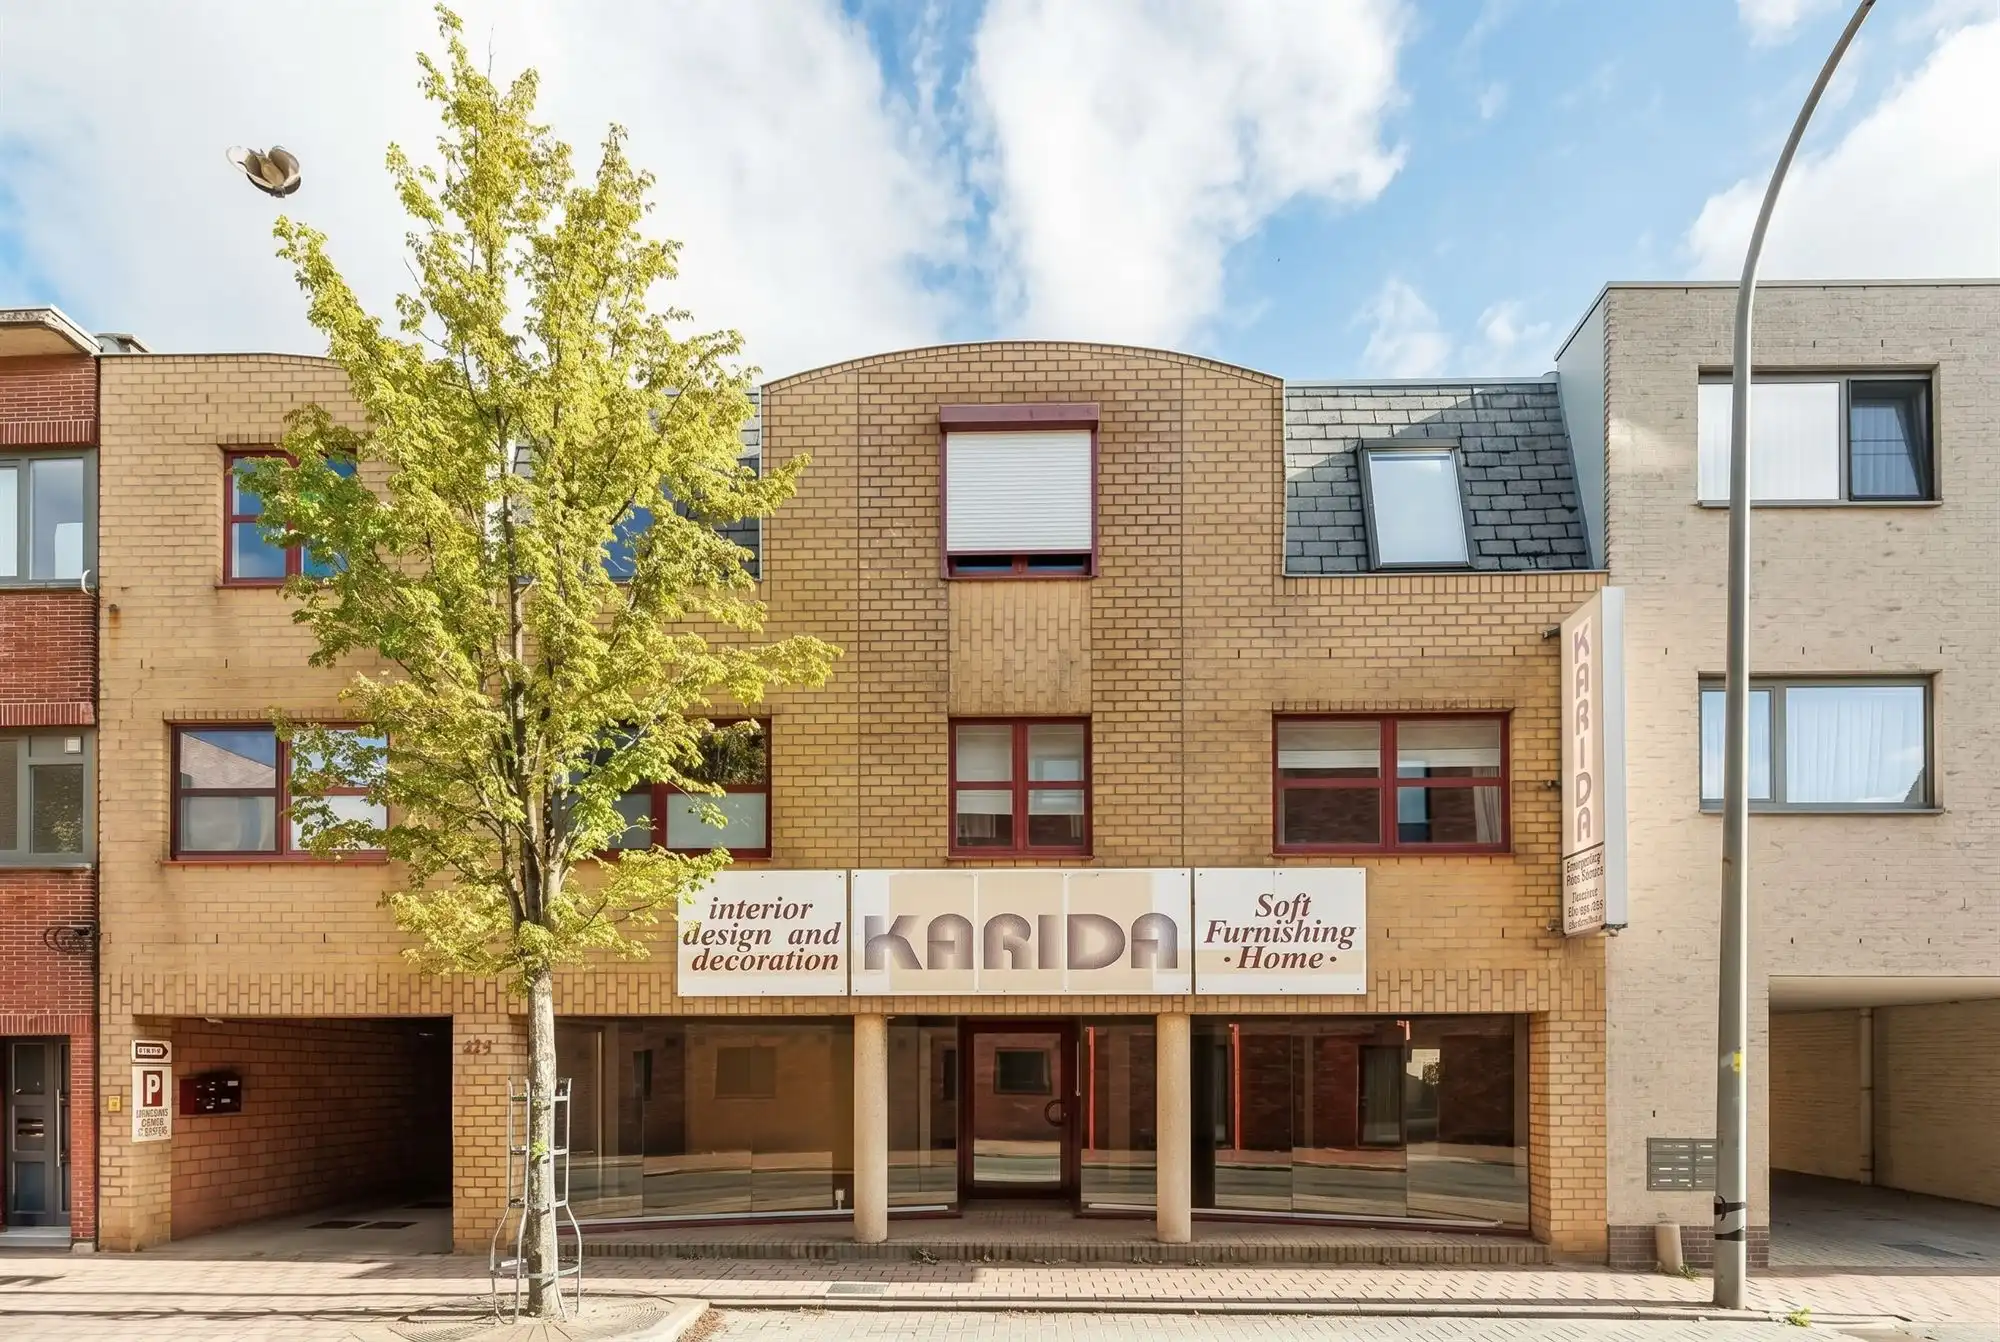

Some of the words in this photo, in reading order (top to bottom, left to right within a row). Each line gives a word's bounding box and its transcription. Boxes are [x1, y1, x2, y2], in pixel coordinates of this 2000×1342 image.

[1573, 623, 1592, 843] KARIDA
[708, 896, 814, 920] interior
[1254, 893, 1312, 925] Soft
[683, 922, 772, 953] design
[787, 922, 842, 945] and
[864, 913, 1178, 970] KARIDA
[1204, 919, 1357, 950] Furnishing
[691, 947, 839, 971] decoration
[1236, 945, 1324, 969] Home
[146, 1074, 161, 1105] P
